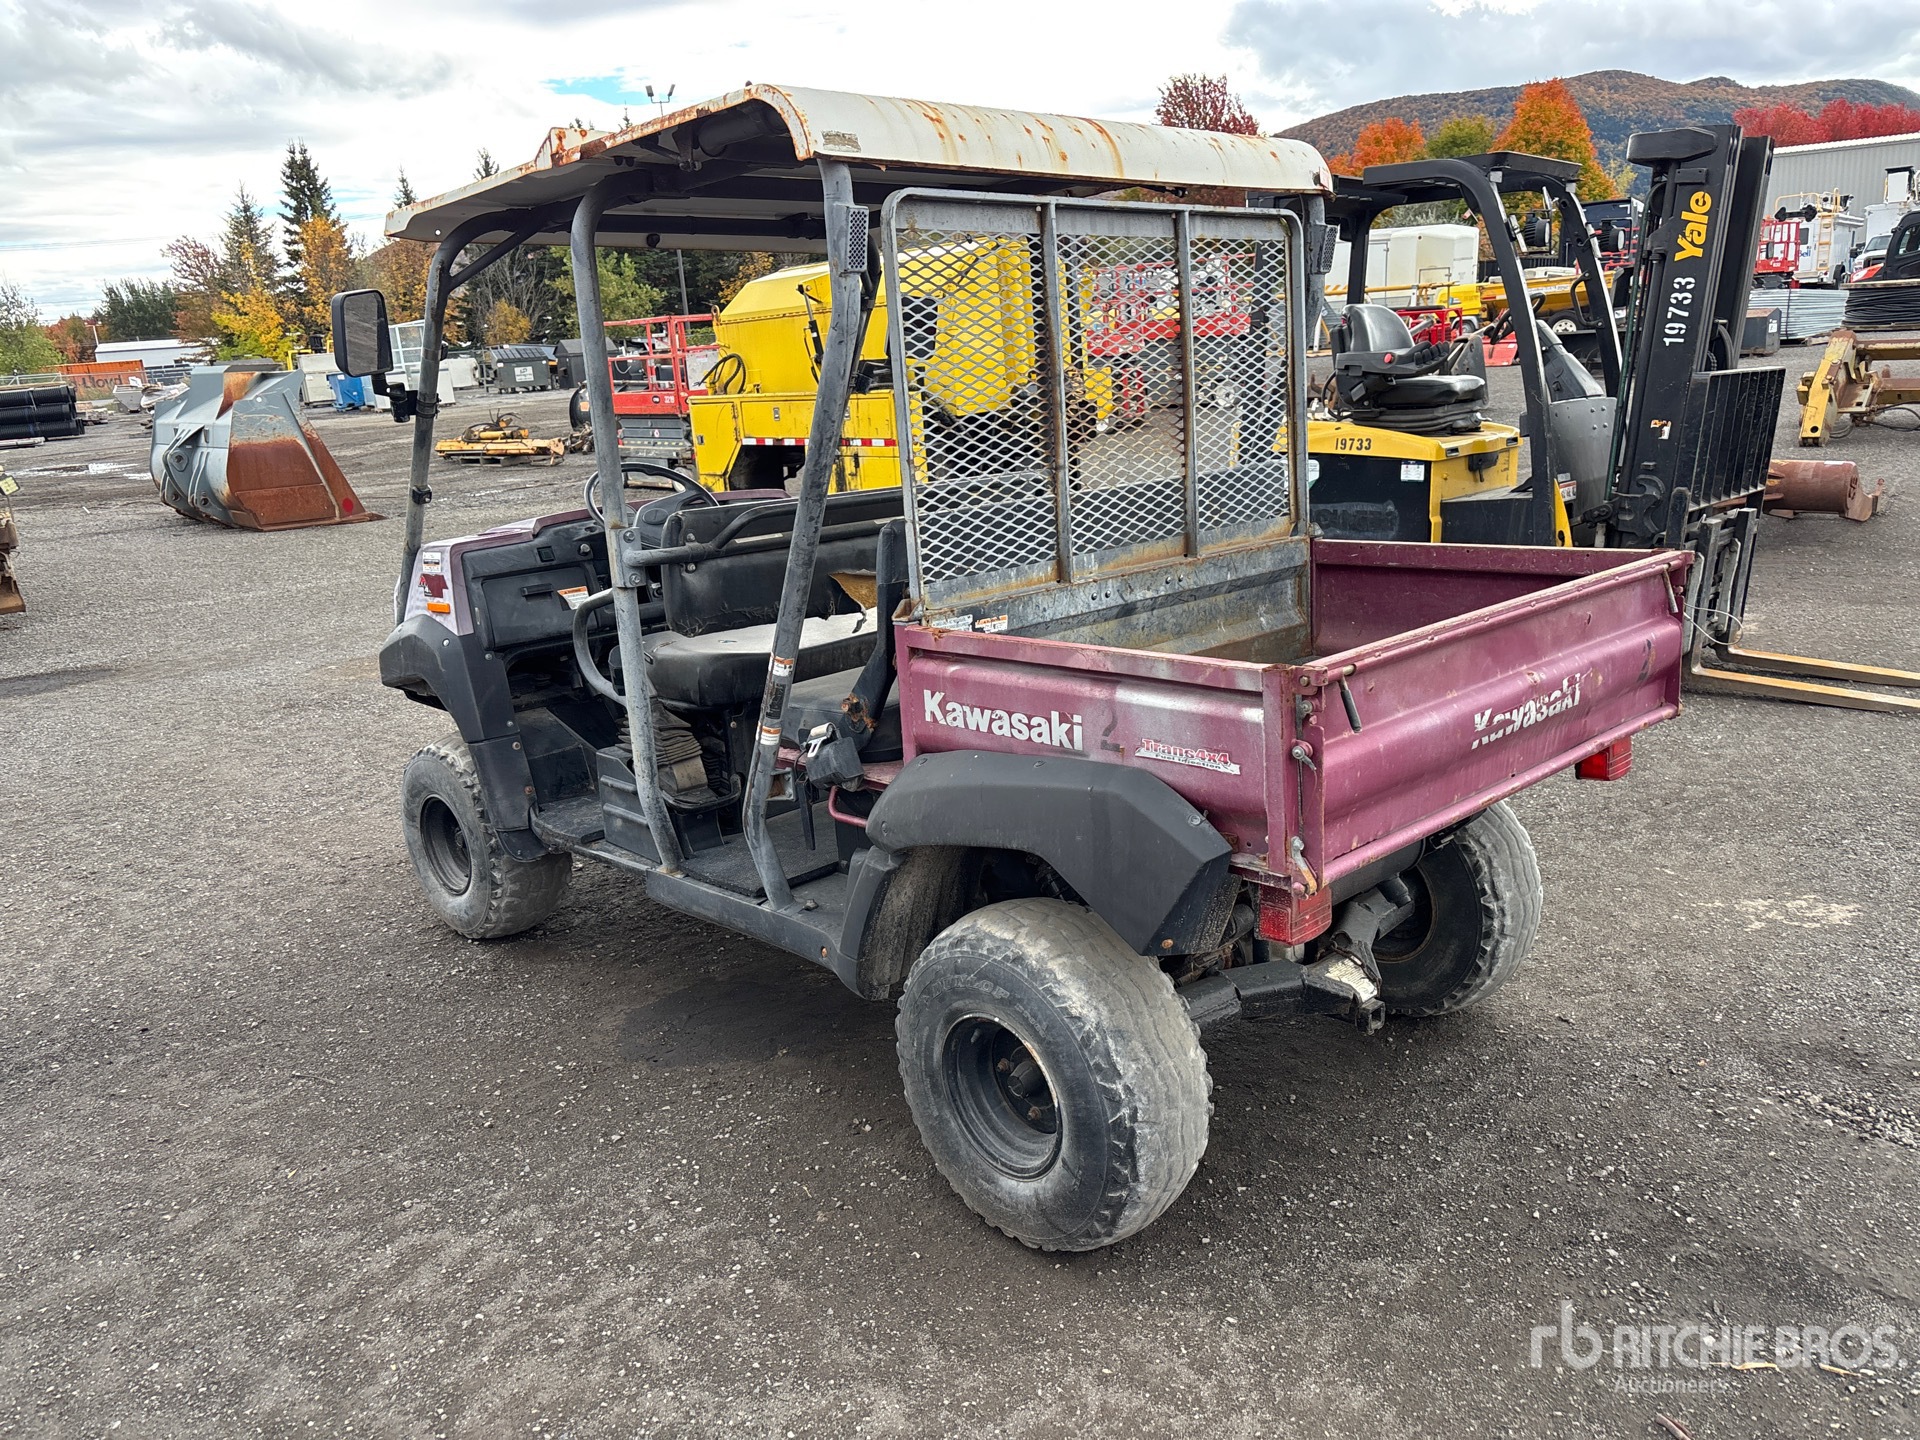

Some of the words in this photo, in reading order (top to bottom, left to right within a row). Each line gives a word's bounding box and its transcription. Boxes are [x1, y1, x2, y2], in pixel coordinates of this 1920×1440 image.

[1673, 190, 1712, 262] Yale
[1662, 276, 1696, 347] 19733
[1334, 437, 1373, 451] 19733
[923, 689, 1083, 751] Kawasaki
[1141, 738, 1231, 767] Trans4x4
